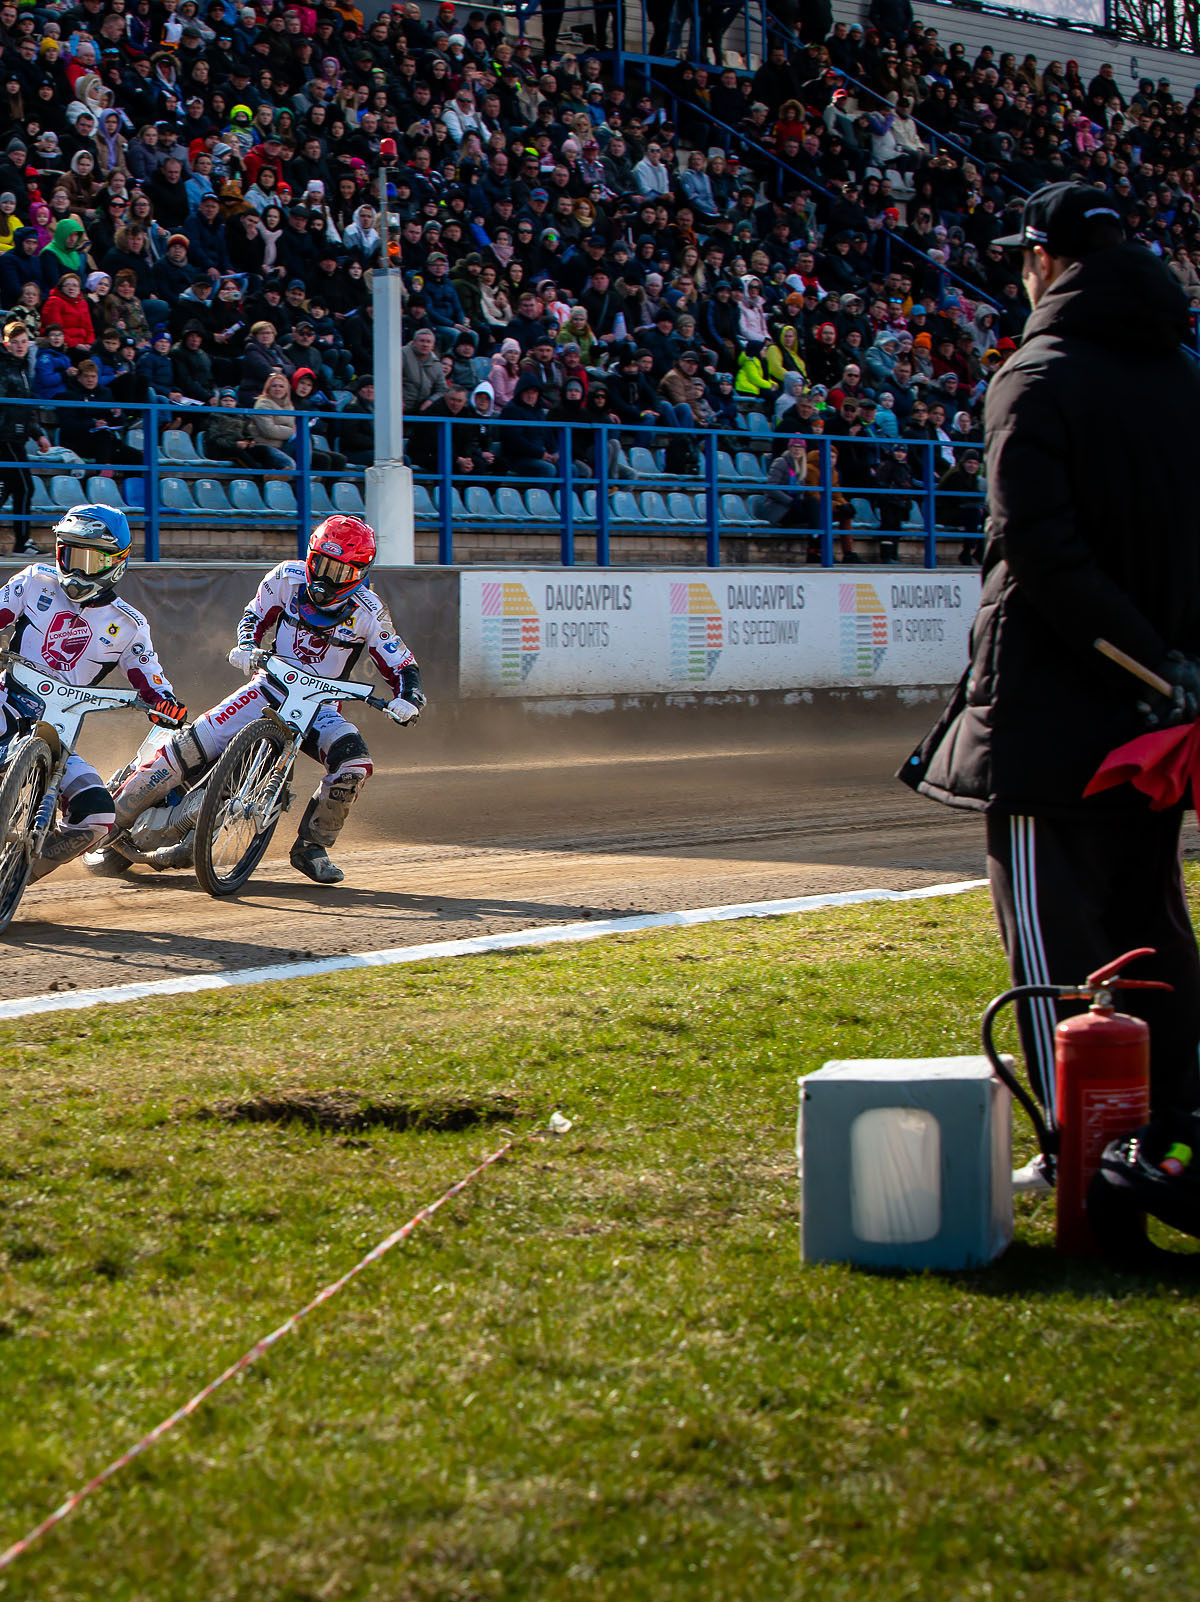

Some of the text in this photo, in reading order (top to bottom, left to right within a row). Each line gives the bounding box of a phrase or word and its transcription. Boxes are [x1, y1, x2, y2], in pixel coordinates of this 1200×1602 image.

[545, 584, 632, 611] DAUGAVPILS
[727, 584, 805, 610] DAUGAVPILS
[891, 584, 961, 609] DAUGAVPILS
[49, 629, 89, 640] LOKOMOTIV
[545, 621, 610, 648] IR SPORTS
[728, 620, 800, 645] IS SPEEDWAY
[892, 618, 945, 642] IR SPORTS
[57, 686, 102, 707] OPTIBET
[300, 676, 341, 696] OPTIBET
